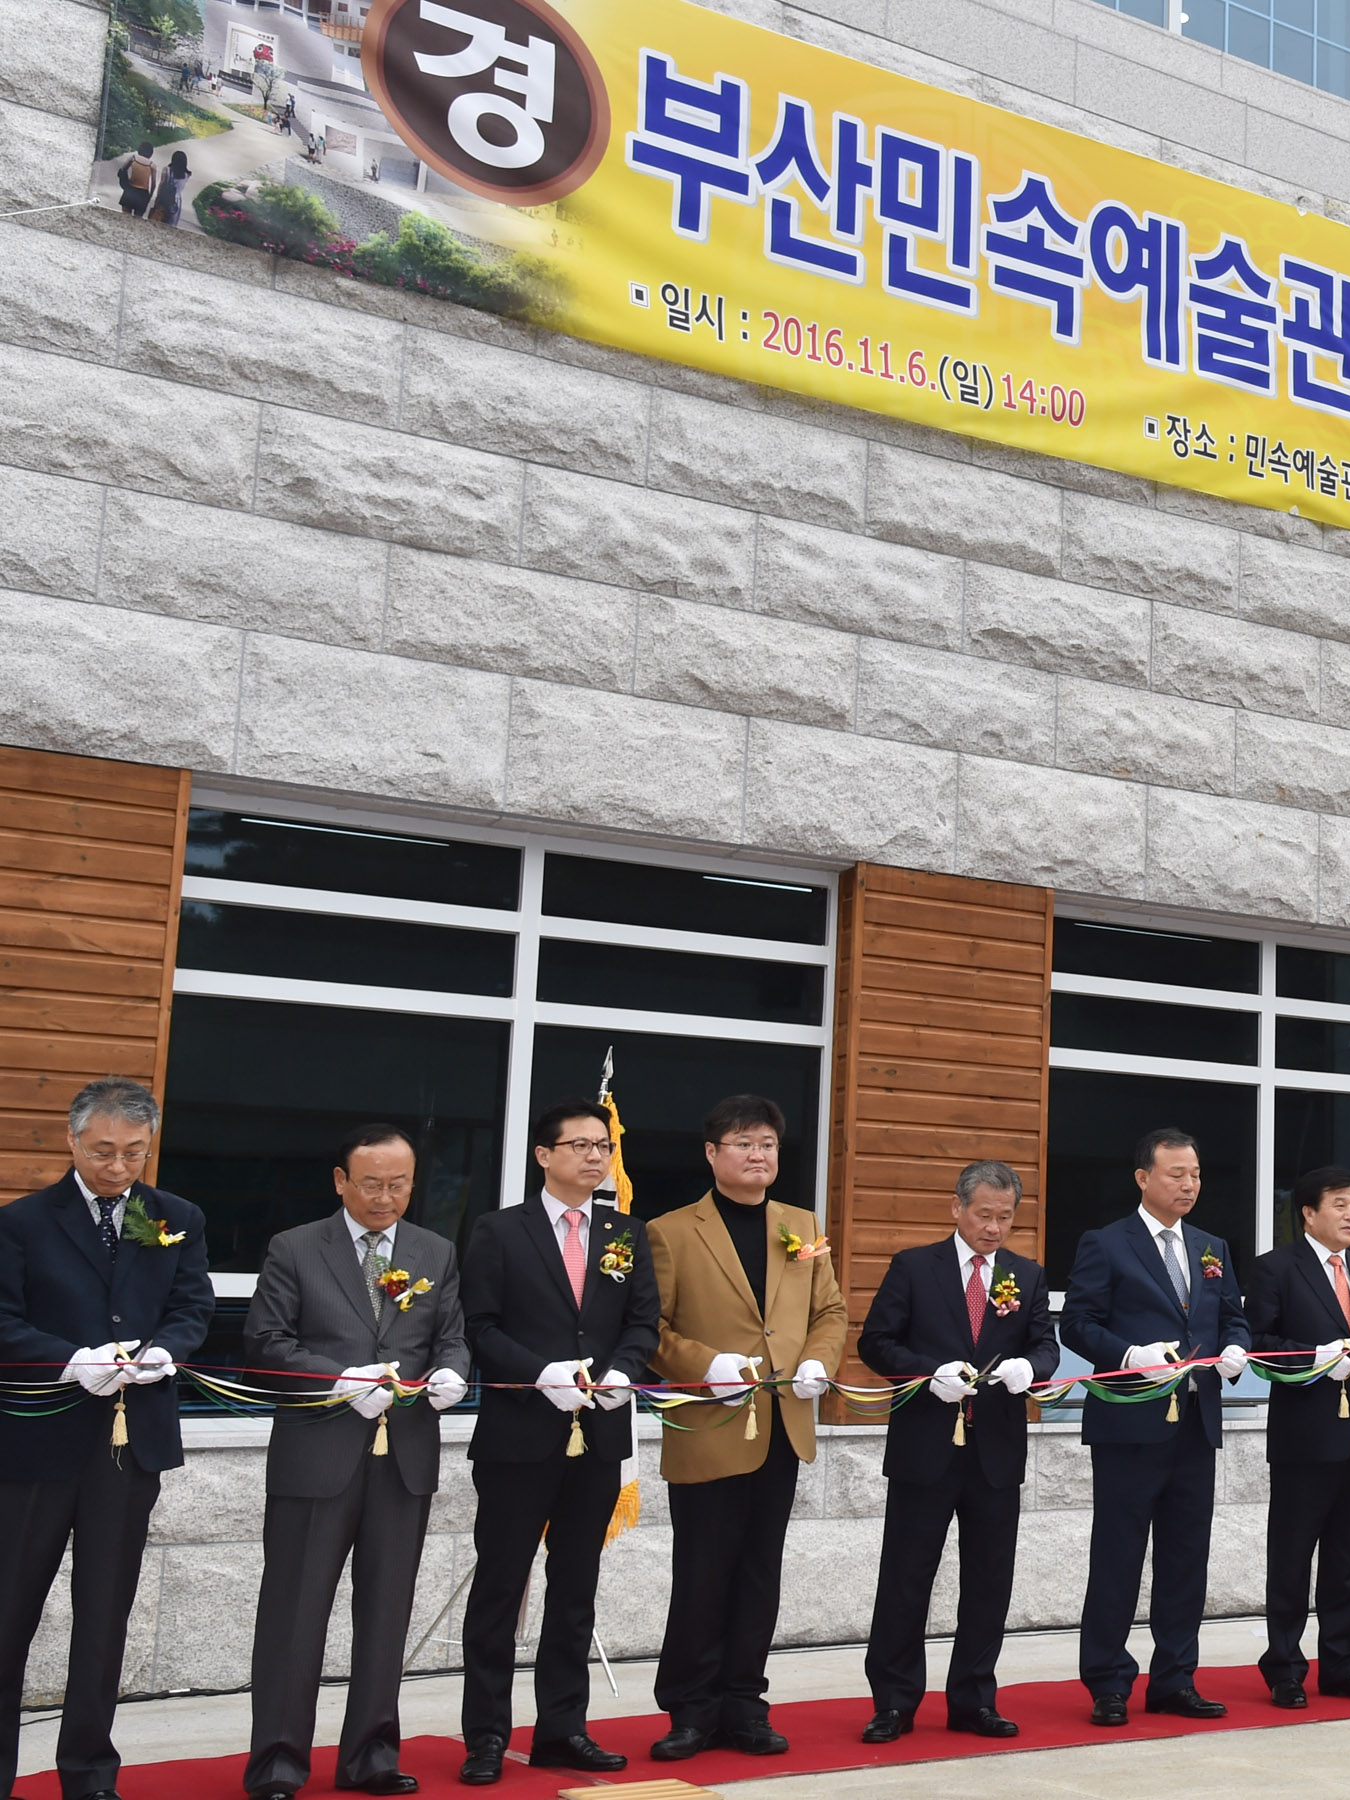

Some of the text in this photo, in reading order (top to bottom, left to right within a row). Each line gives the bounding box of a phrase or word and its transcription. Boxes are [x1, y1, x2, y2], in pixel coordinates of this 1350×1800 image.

[412, 0, 556, 169] 경
[661, 283, 724, 341] 일시
[763, 311, 994, 410] 2016.11.6.(일)
[1002, 373, 1086, 427] 14:00
[1166, 414, 1218, 459] 장소
